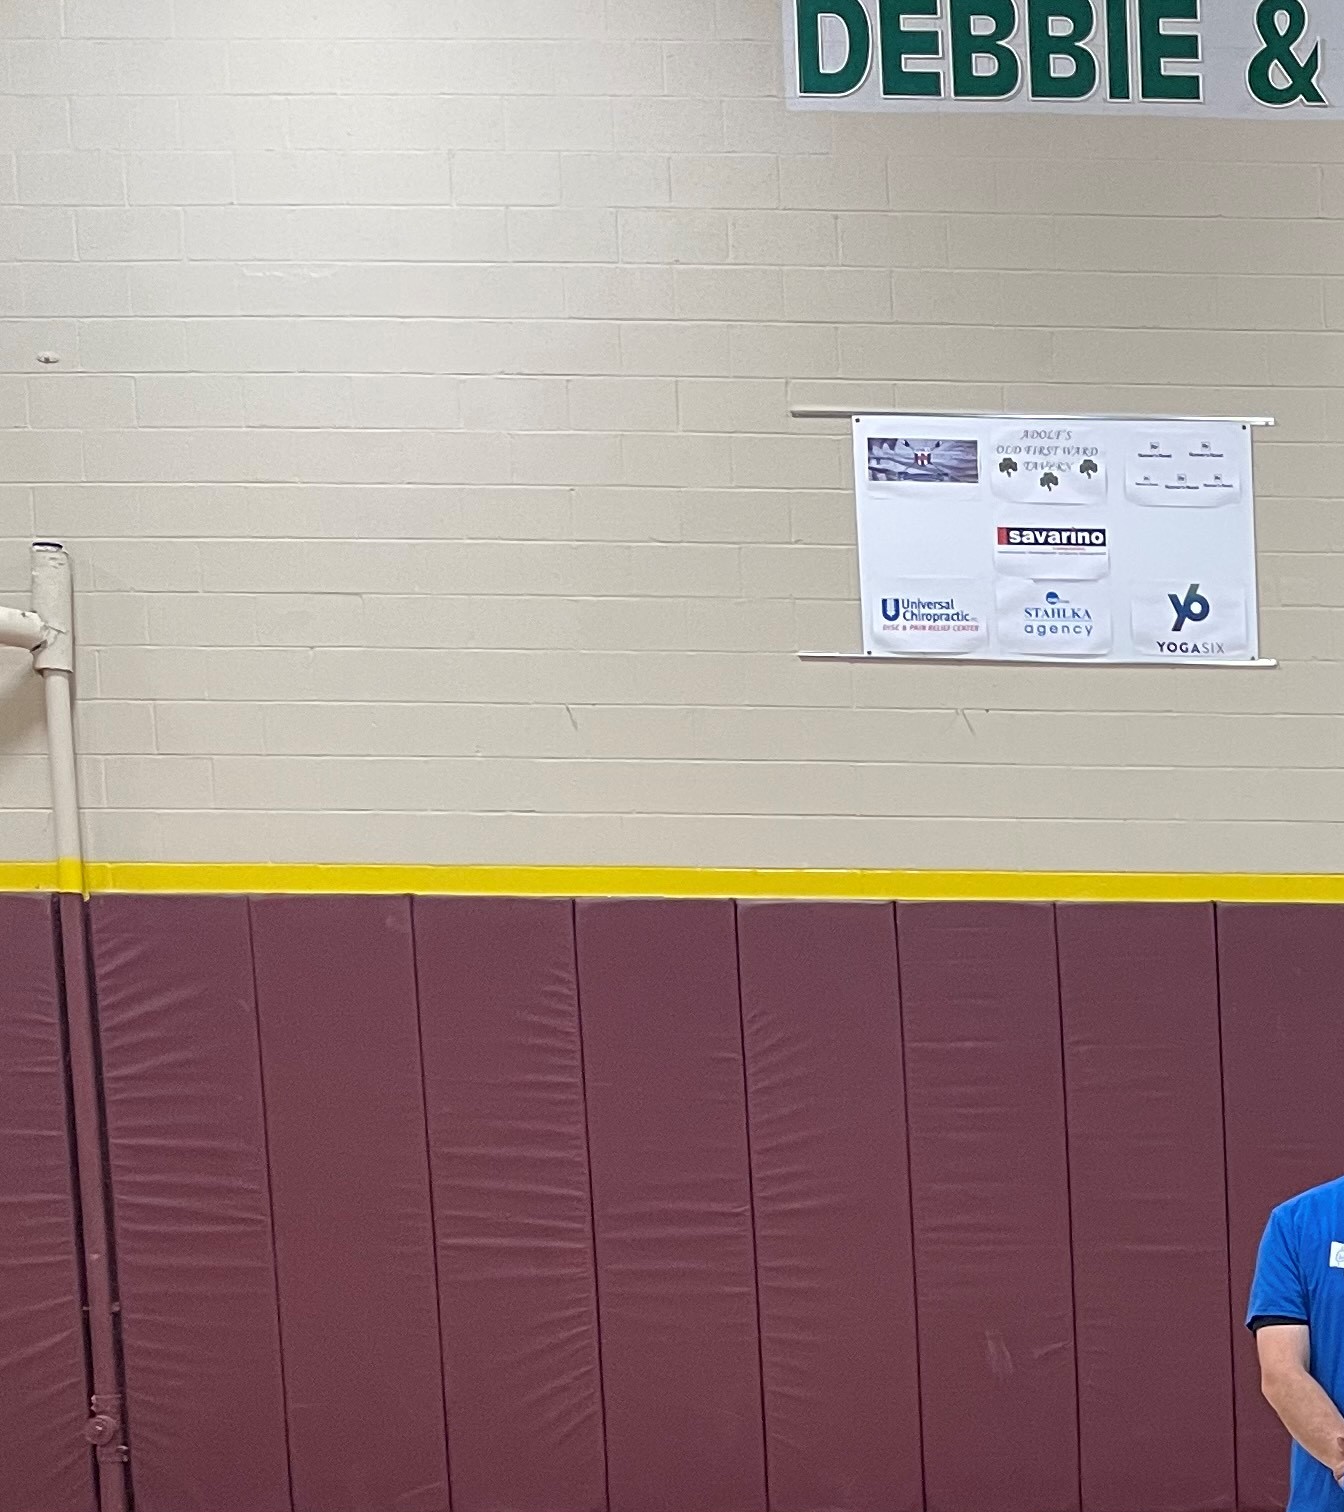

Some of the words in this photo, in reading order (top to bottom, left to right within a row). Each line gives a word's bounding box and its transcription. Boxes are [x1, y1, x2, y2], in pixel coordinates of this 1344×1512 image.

[795, 0, 1203, 102] DEBBIE
[1246, 0, 1328, 107] &
[996, 445, 1022, 454] OLD
[1024, 445, 1060, 456] FIRST
[1062, 446, 1098, 457] WARD
[1009, 530, 1104, 545] savarino
[902, 598, 955, 610] Universal
[903, 610, 970, 623] Chiropractic
[1024, 624, 1093, 636] agency
[1156, 641, 1224, 654] YOGASIX
